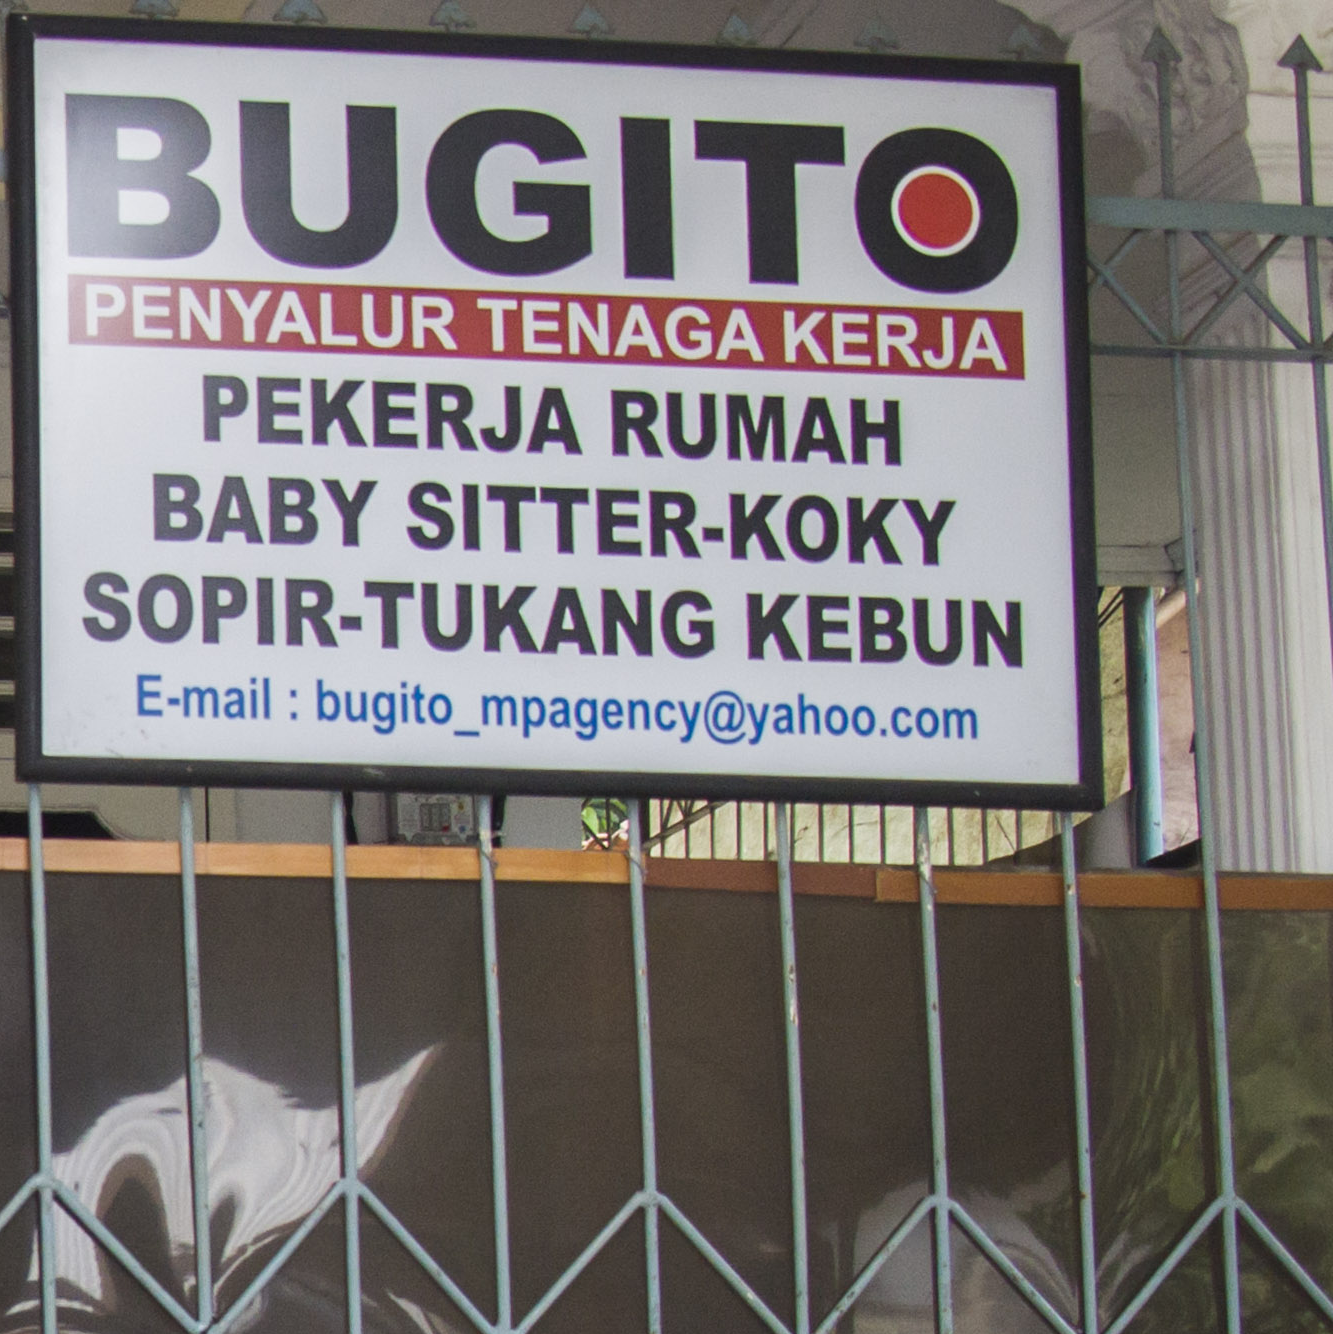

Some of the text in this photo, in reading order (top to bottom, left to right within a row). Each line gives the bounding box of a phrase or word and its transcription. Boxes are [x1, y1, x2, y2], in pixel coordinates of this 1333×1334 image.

[66, 93, 1019, 293] BUGITO
[85, 284, 1007, 371] PENYALUR TENAGA KERJA
[203, 375, 901, 465] PEKERJA RUMAH
[153, 473, 957, 565] BABY SITTER-KOKY
[83, 572, 1023, 667] SOPIR-TUKANG KEBUN
[136, 674, 273, 720] E-mail
[316, 678, 979, 746] bugito_mpagency@yahoo.com
